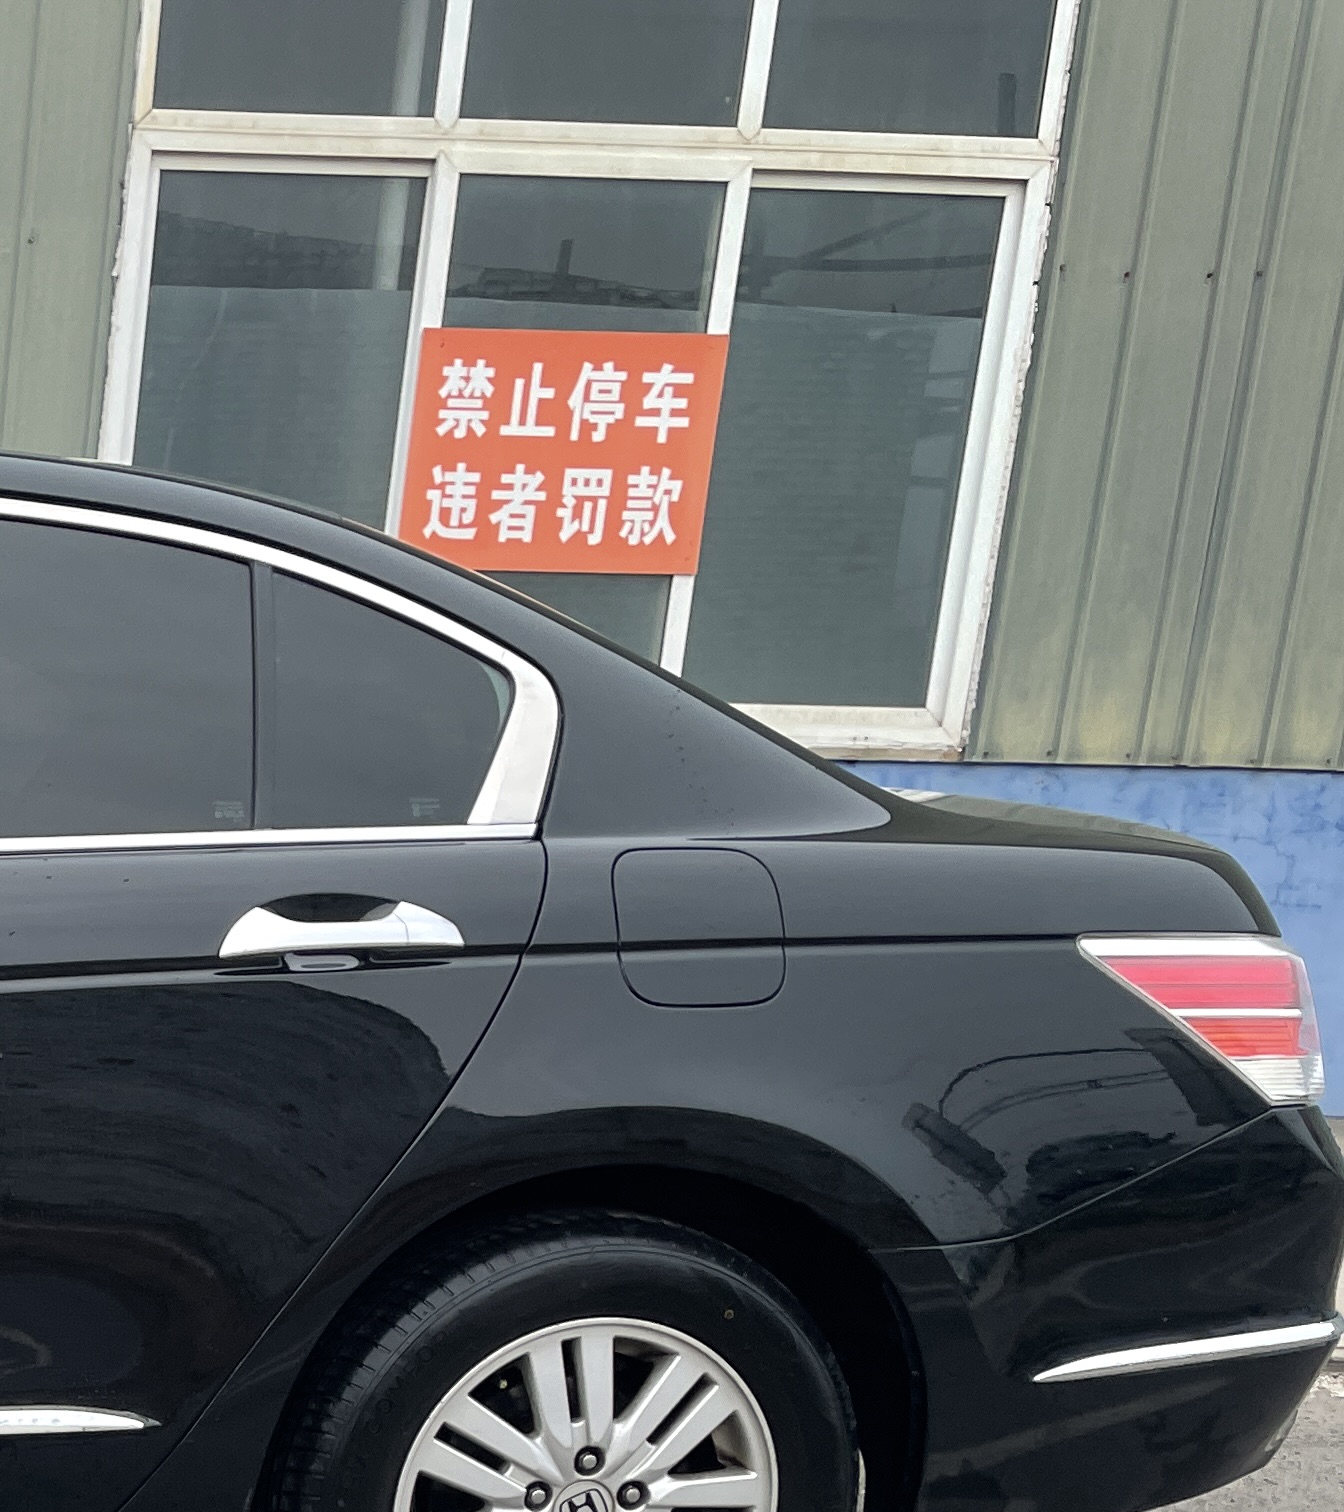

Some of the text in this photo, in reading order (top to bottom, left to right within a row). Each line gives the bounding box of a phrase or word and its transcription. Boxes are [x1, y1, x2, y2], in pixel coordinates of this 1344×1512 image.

[434, 358, 695, 444] 禁止停车
[422, 462, 684, 546] 违者罚款
